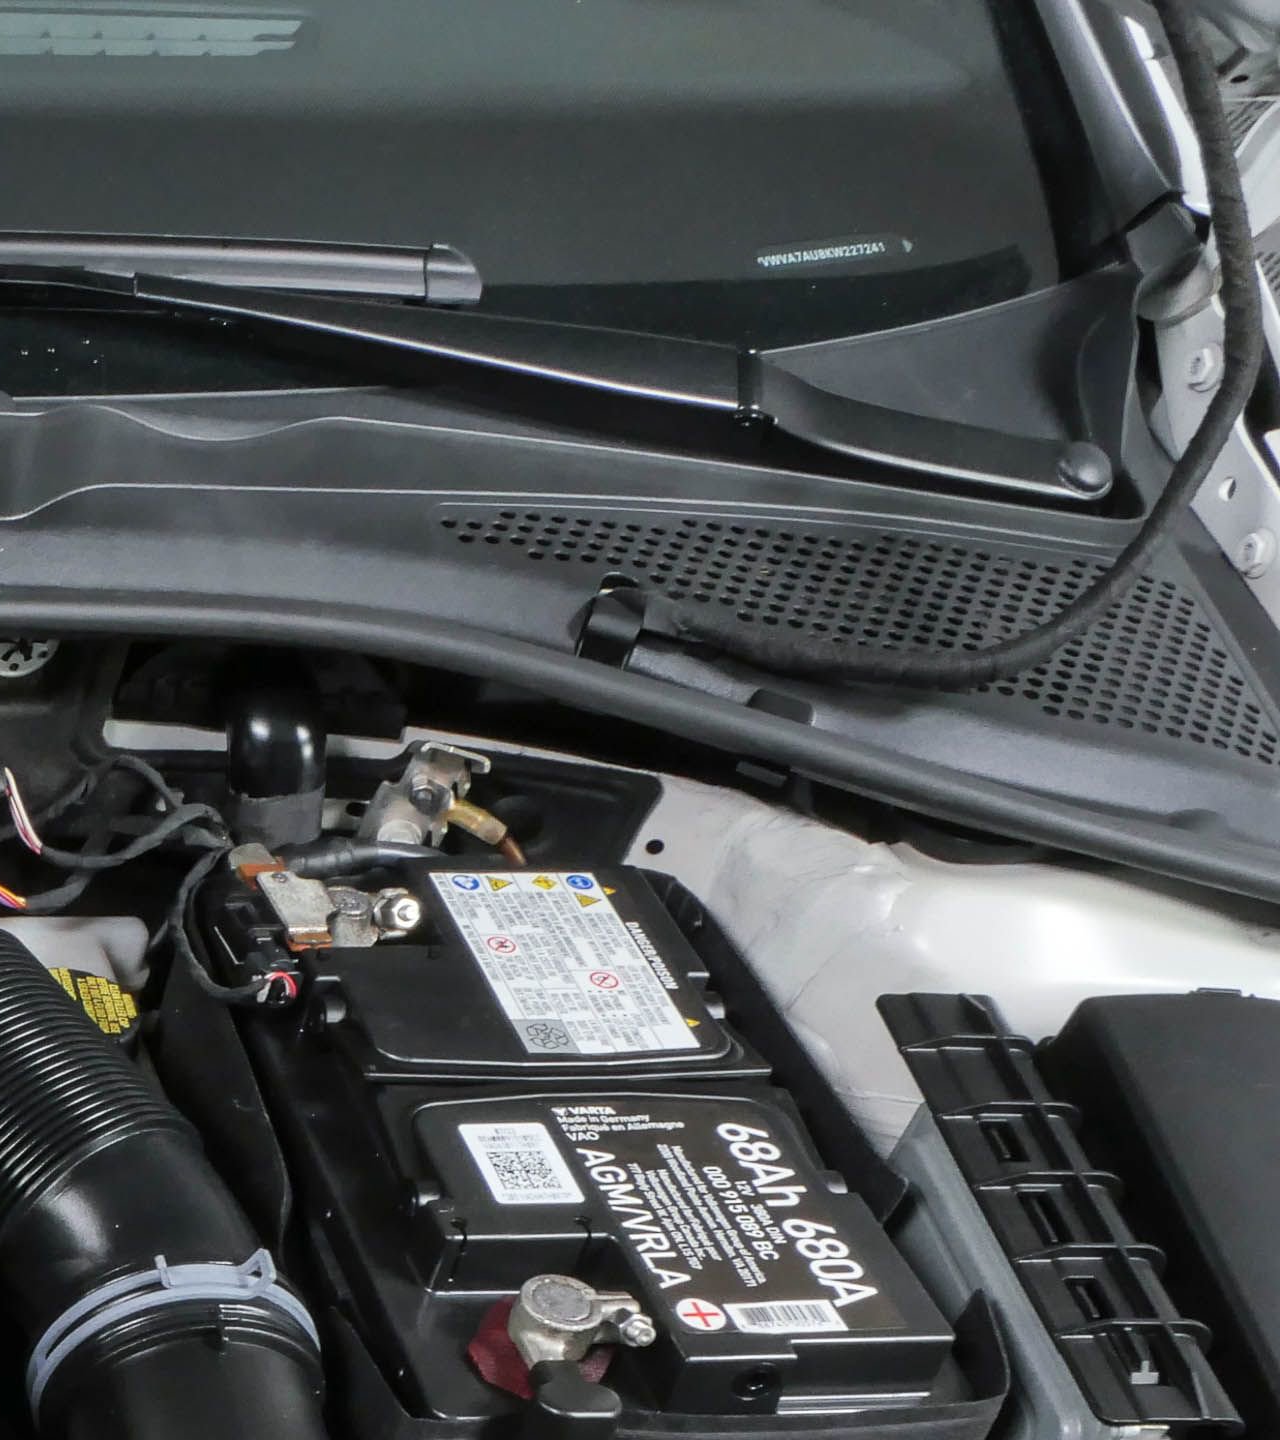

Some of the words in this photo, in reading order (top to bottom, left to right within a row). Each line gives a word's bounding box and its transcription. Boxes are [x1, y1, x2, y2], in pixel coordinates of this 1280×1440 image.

[556, 1115, 588, 1125] Made
[600, 1114, 650, 1124] Germany
[567, 1106, 617, 1116] VARTA
[575, 1147, 691, 1289] AGM/VRLA
[701, 1165, 732, 1188] 000
[718, 1189, 749, 1213] 915
[734, 1214, 765, 1238] 089
[750, 1240, 780, 1260] BC
[716, 1122, 807, 1207] 68Ah
[781, 1218, 878, 1305] 680A
